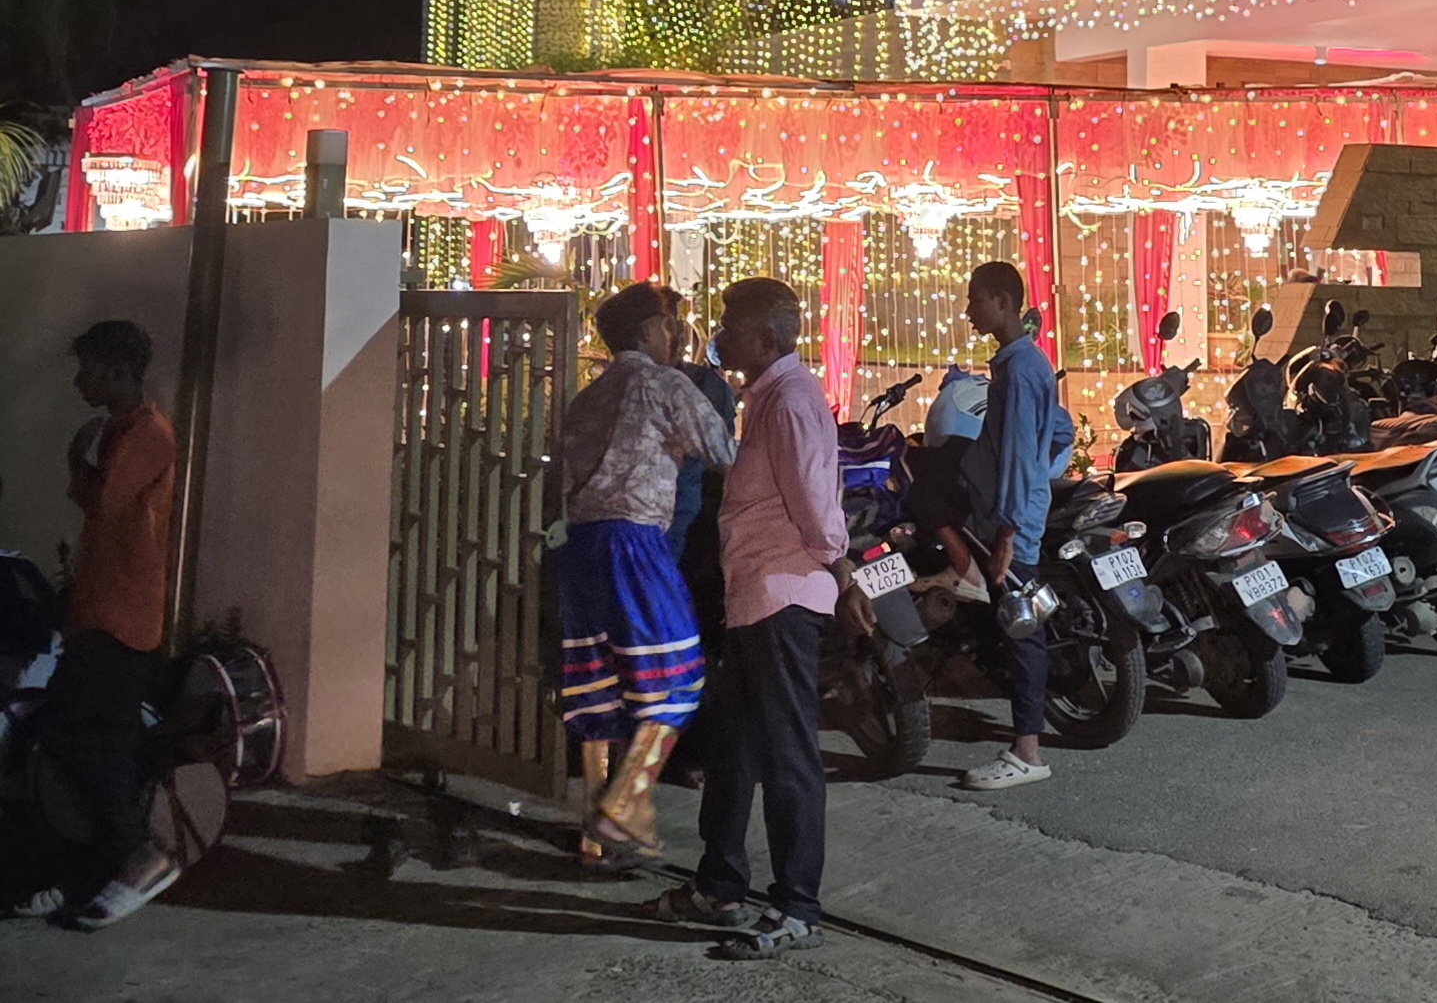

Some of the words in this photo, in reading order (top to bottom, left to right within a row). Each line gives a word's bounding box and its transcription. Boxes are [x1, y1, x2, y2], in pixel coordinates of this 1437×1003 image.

[863, 558, 898, 580] PY02
[1107, 550, 1135, 569] PY02
[1243, 567, 1272, 587] PY01
